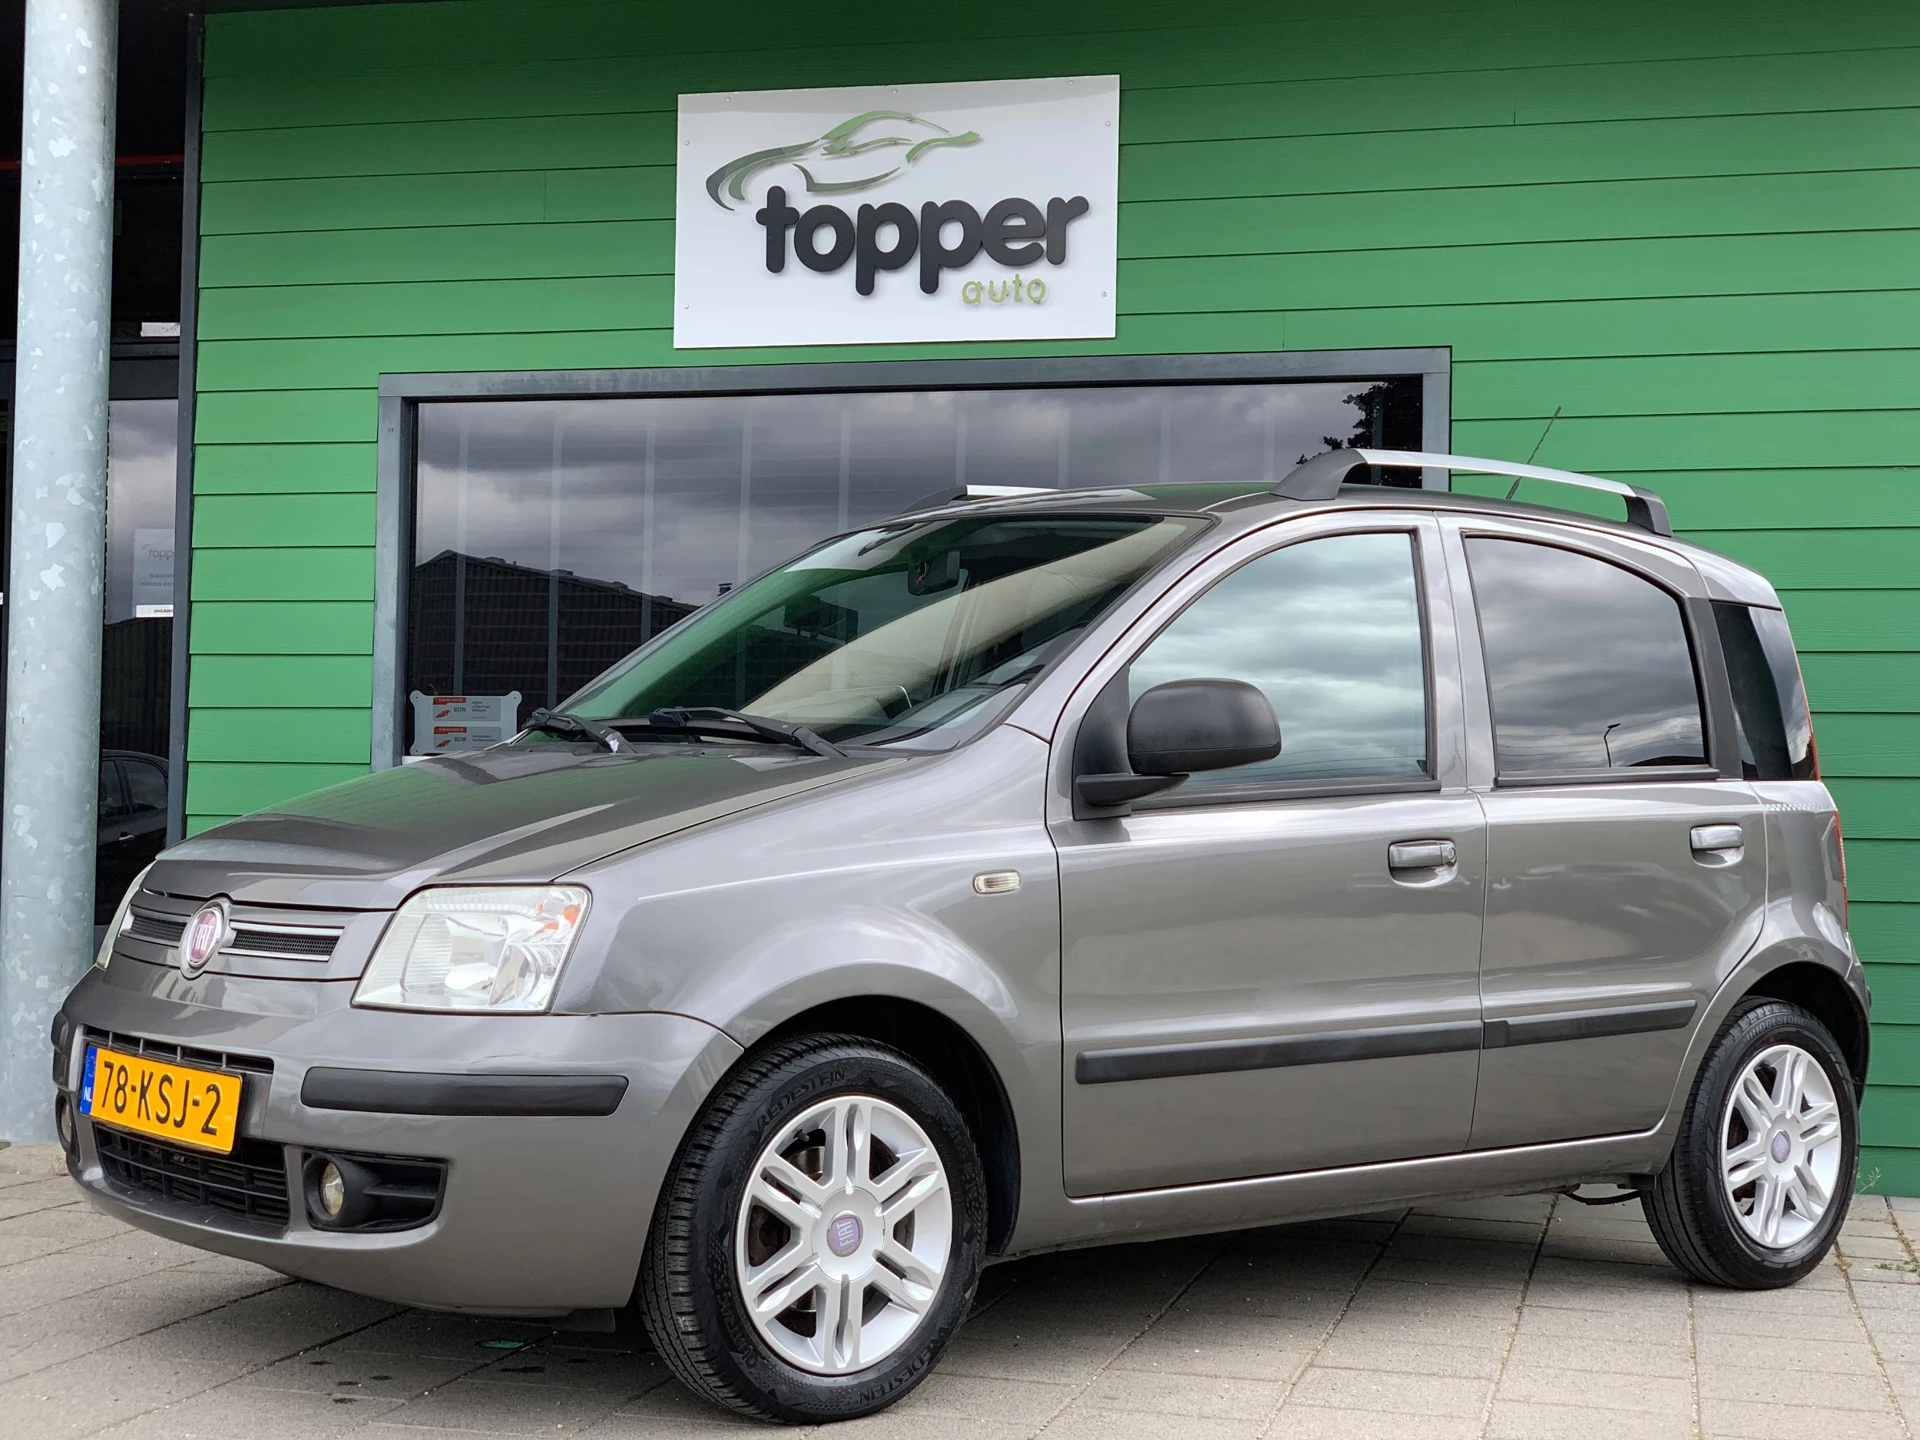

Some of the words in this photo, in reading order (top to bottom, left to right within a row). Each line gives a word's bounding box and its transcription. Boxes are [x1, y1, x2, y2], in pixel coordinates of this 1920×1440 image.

[755, 185, 1090, 296] topper
[961, 273, 1046, 305] auto
[191, 923, 214, 951] FIAT
[83, 1086, 92, 1102] NL
[101, 1061, 222, 1136] 78-KSJ-2
[836, 1220, 854, 1247] FIAT
